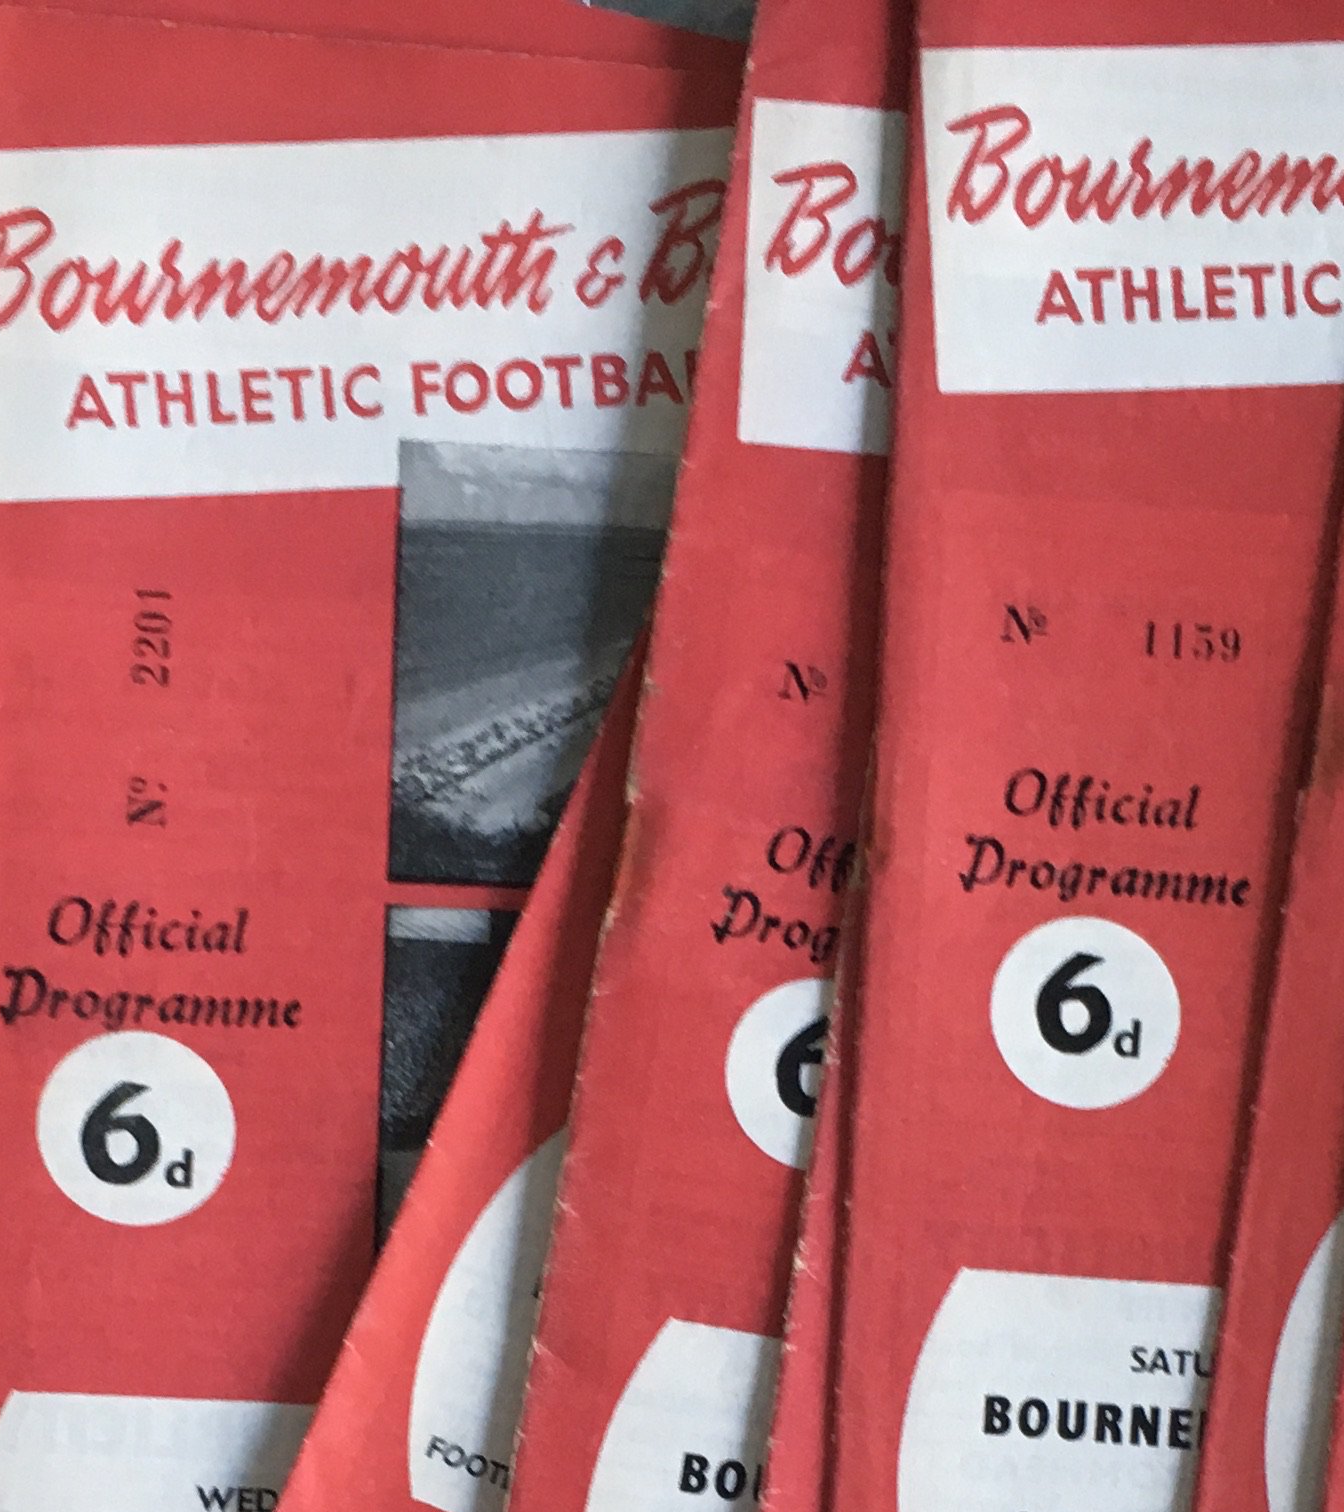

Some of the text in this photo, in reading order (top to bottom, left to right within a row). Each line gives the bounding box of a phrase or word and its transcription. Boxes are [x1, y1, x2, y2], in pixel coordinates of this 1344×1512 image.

[576, 234, 624, 310] &
[1034, 262, 1343, 326] ATHLETIC
[65, 362, 384, 430] ATHLETIC
[131, 588, 174, 688] 2201
[1141, 620, 1243, 664] 1159
[1002, 766, 1201, 832] Official
[962, 833, 1252, 908] Programme
[48, 895, 252, 958] Official
[0, 963, 303, 1031] Programme
